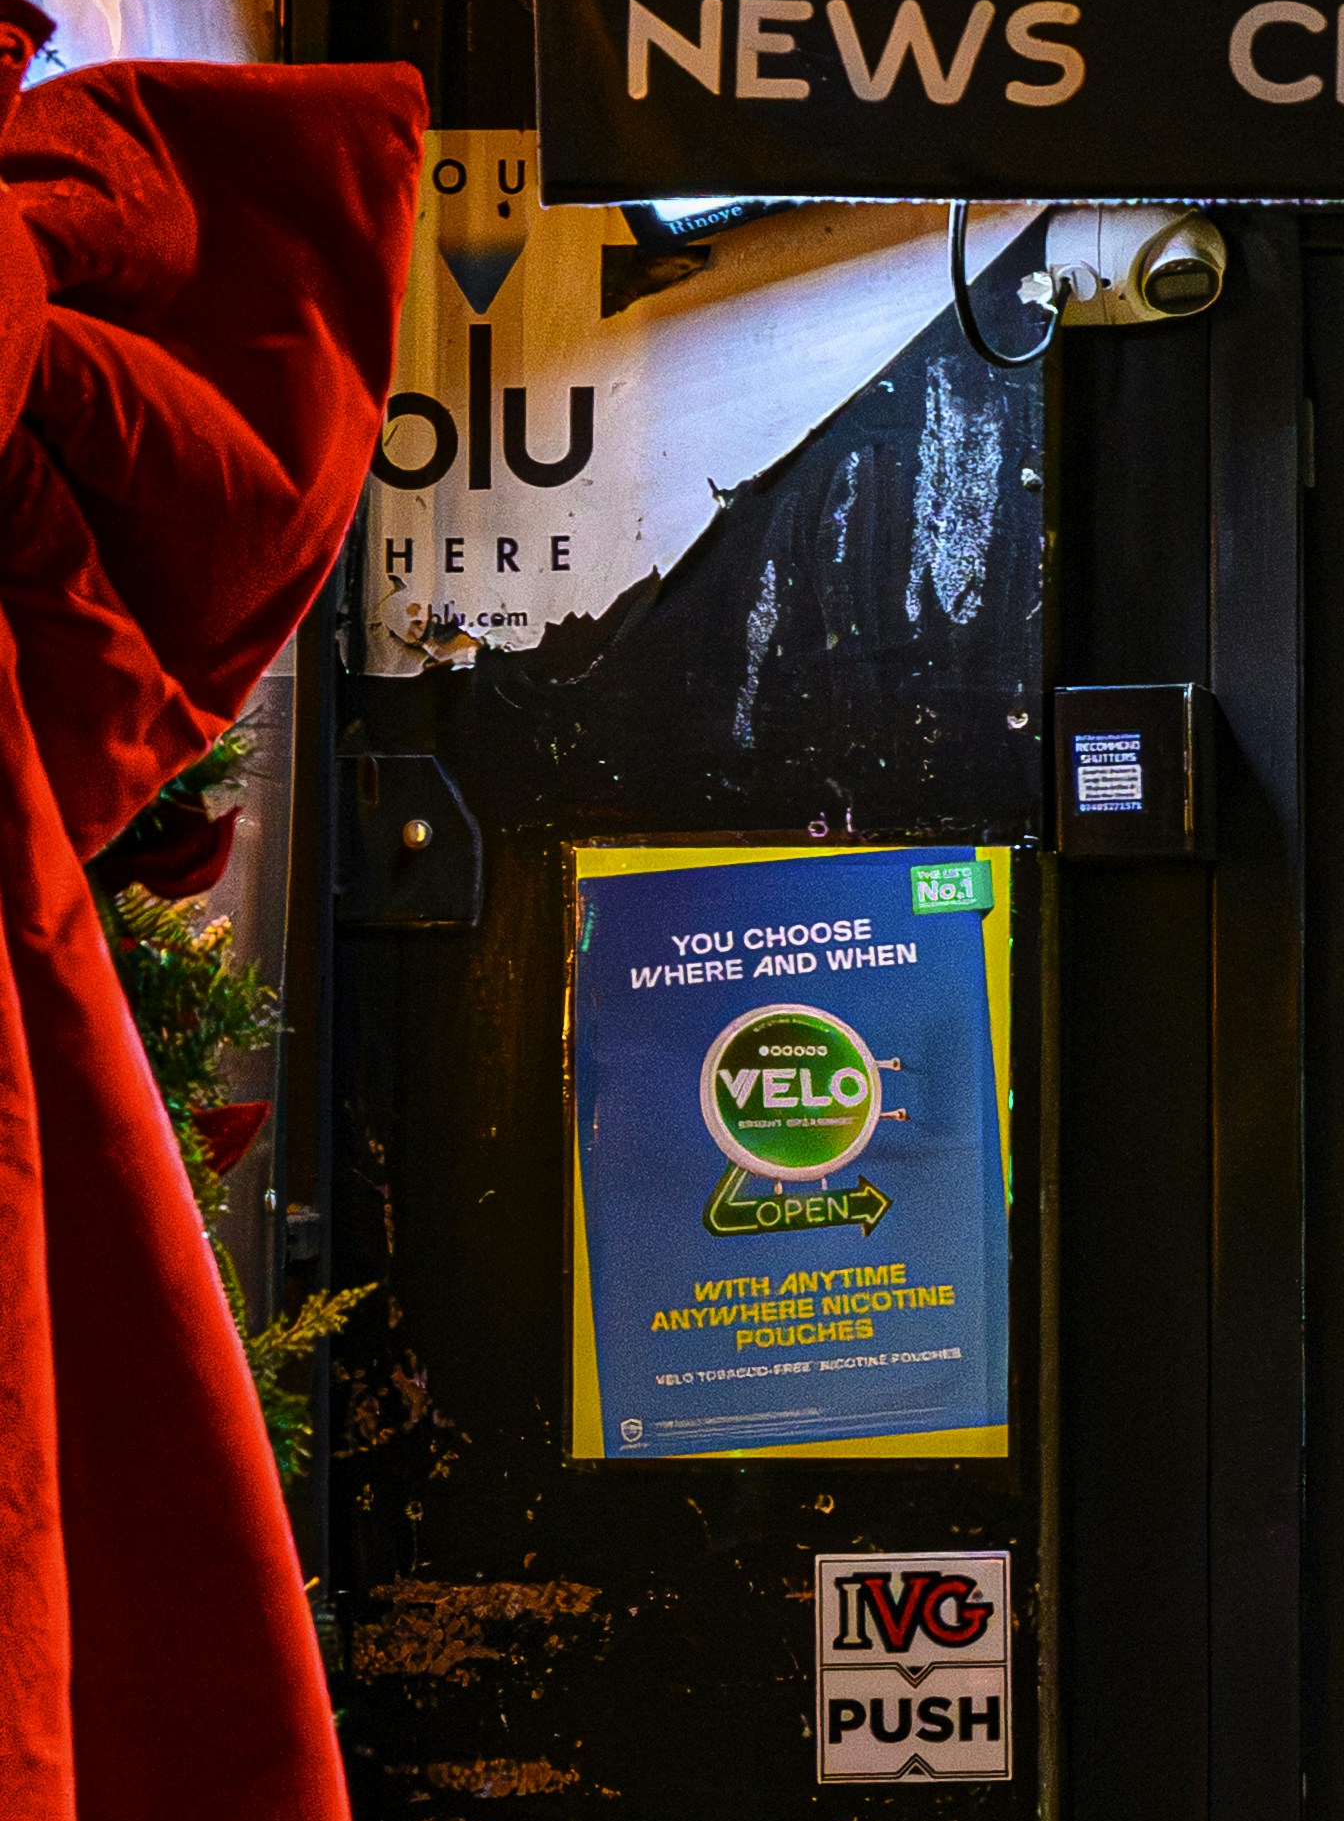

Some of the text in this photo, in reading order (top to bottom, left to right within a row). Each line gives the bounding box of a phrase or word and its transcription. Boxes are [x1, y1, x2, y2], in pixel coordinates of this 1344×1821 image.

[384, 535, 572, 574] HERE
[917, 878, 975, 903] No.1
[671, 918, 872, 957] YOU CHOOSE
[630, 942, 918, 990] WHERE AND WHEN
[717, 1067, 869, 1110] VELO
[755, 1194, 850, 1227] OPEN
[694, 1262, 907, 1303] WITH ANYTIME
[651, 1284, 956, 1333] ANYWHERE NICOTINE
[736, 1317, 874, 1352] POUCHES
[832, 1570, 995, 1653] IVG
[828, 1695, 1001, 1744] PUSH
